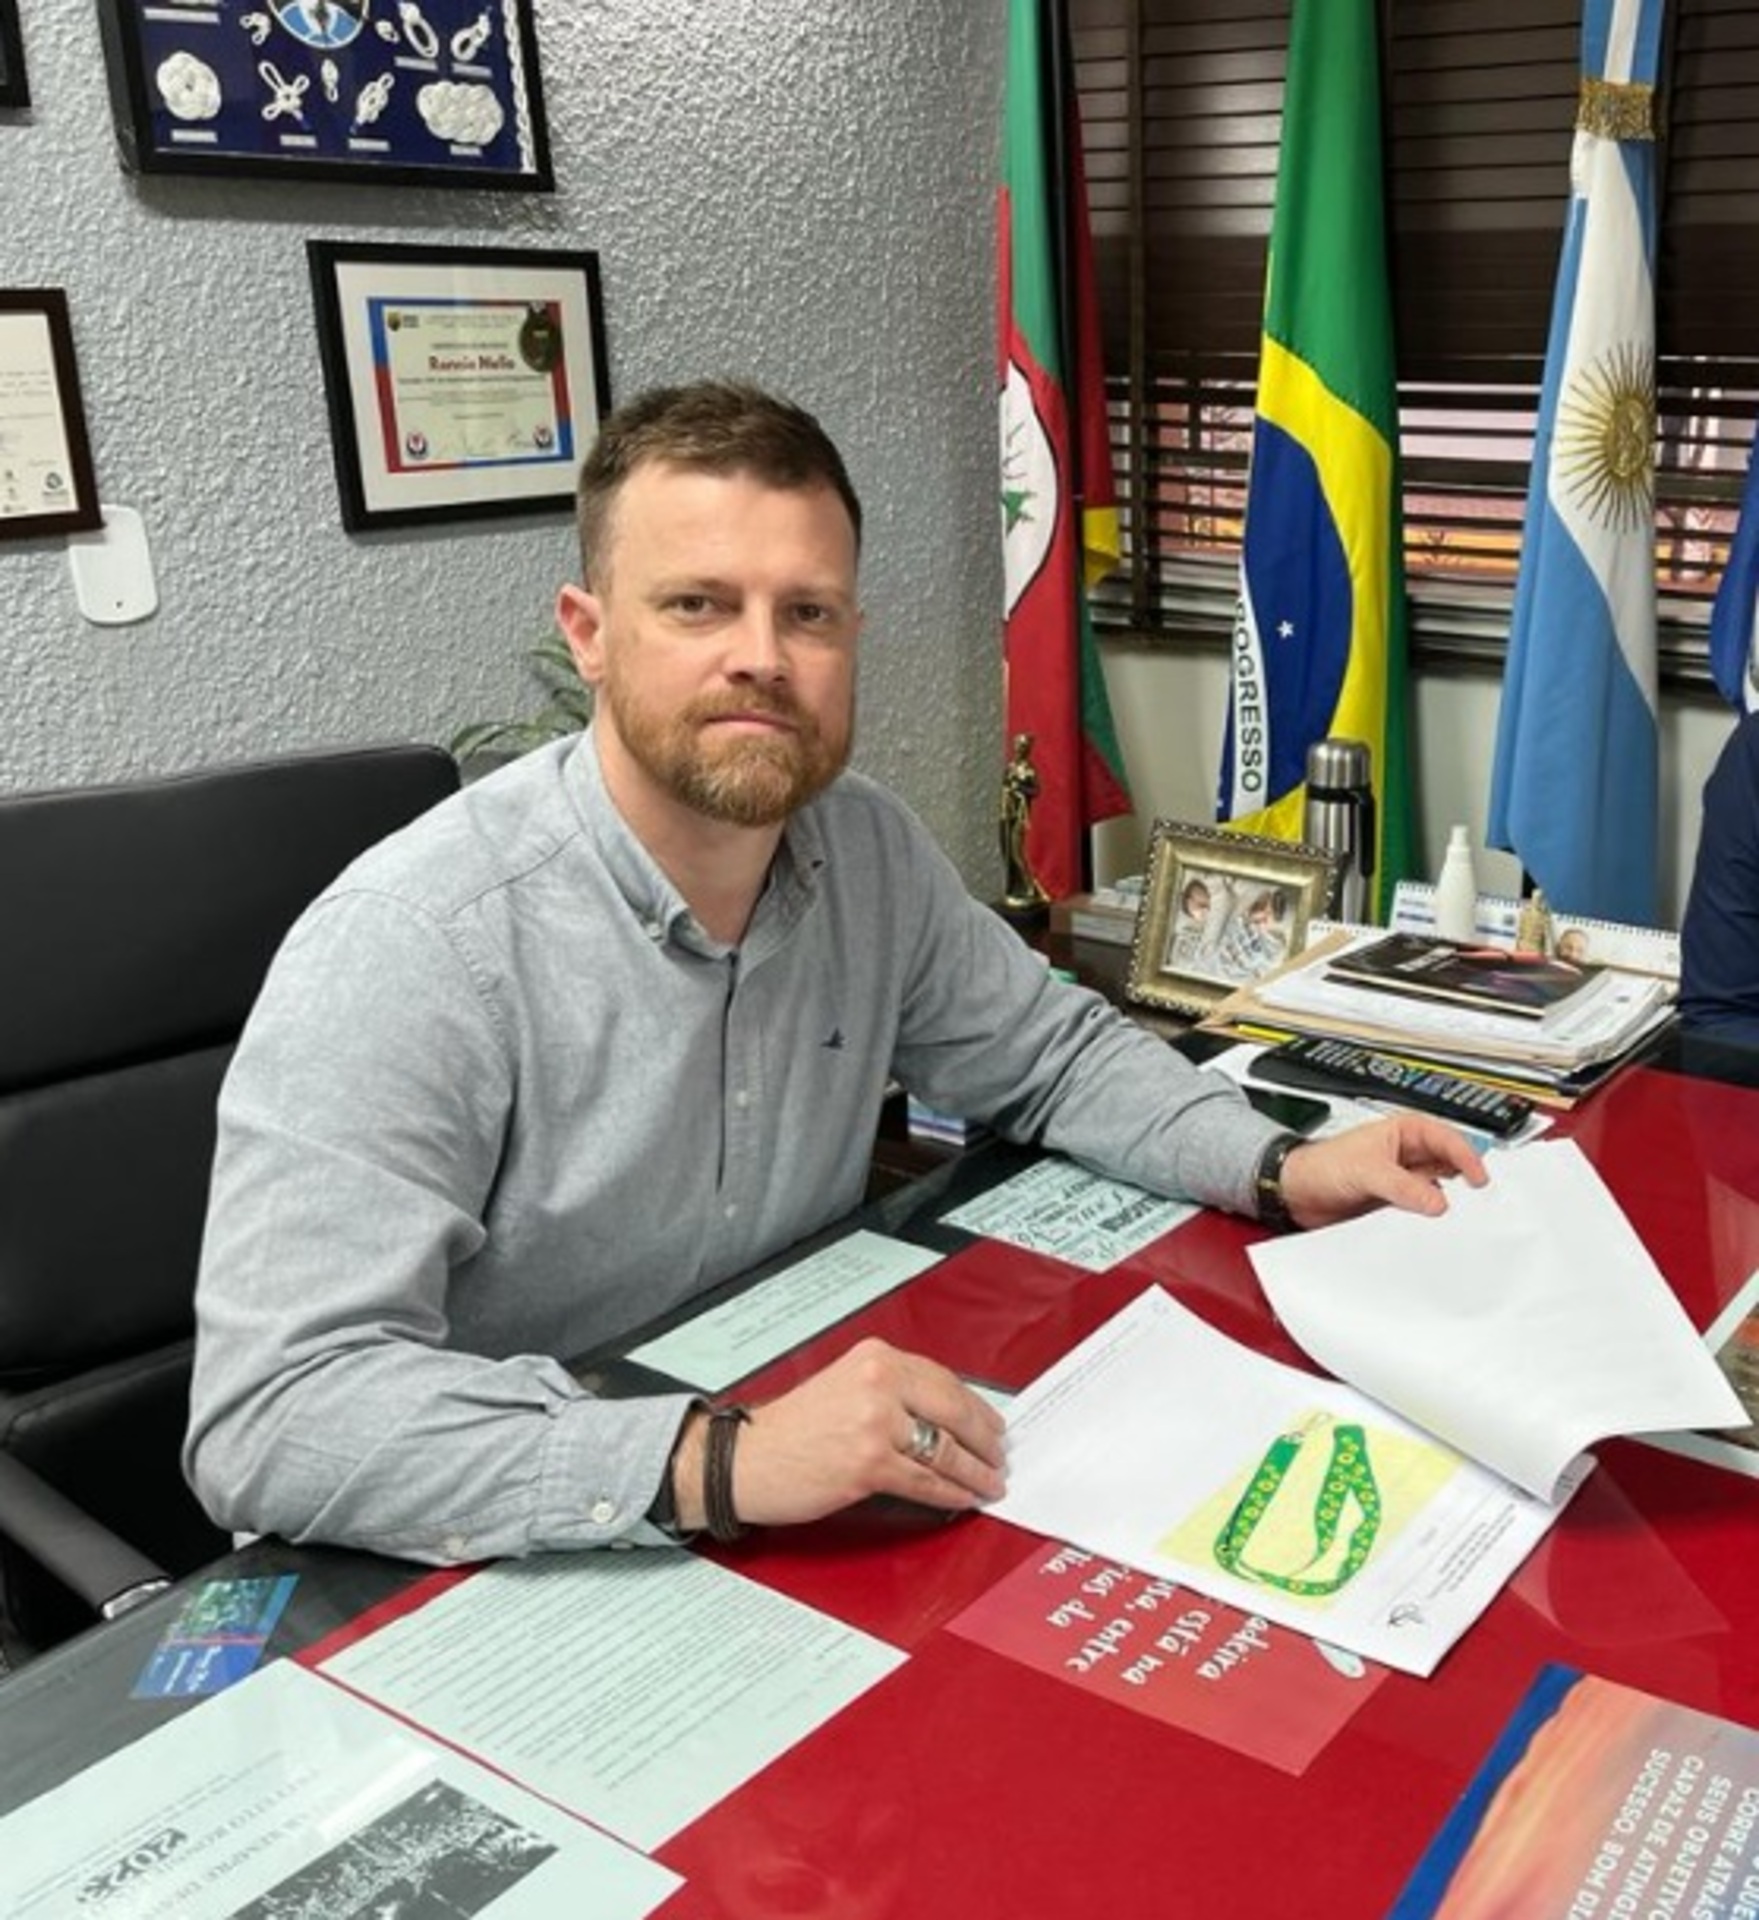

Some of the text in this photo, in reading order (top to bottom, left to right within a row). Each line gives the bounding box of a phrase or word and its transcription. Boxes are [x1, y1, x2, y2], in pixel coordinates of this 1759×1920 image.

[1046, 1598, 1096, 1628] da
[1064, 1617, 1135, 1673] entre
[1120, 1653, 1164, 1685] na
[1660, 1754, 1704, 1819] CAPAZ
[1695, 1773, 1732, 1824] SEUS
[1644, 1817, 1675, 1848] DE
[1720, 1786, 1759, 1856] CORRE
[1585, 1840, 1625, 1890] BOM
